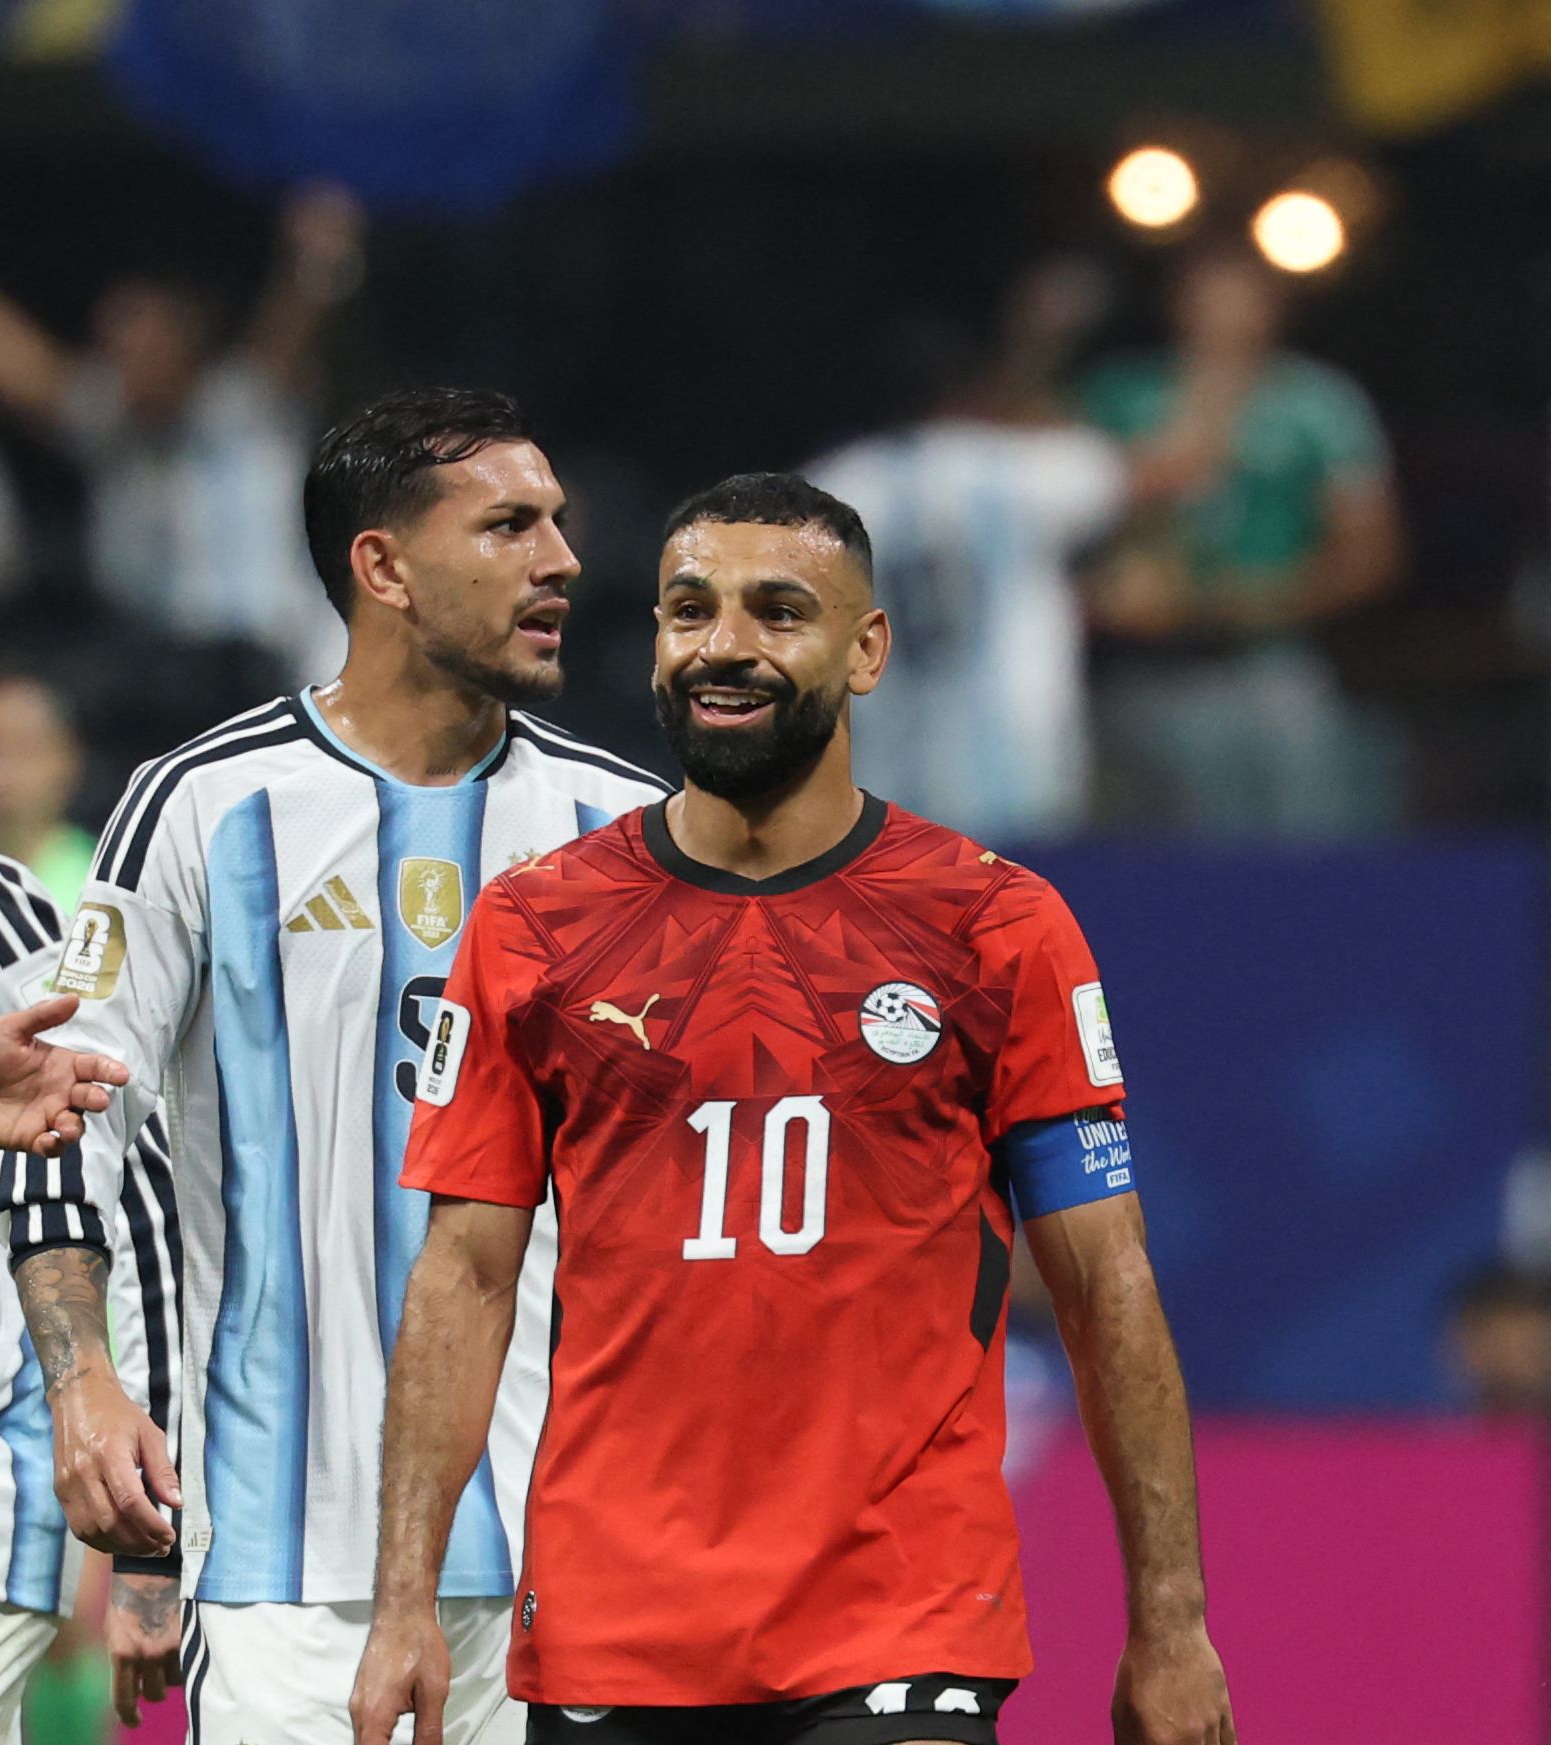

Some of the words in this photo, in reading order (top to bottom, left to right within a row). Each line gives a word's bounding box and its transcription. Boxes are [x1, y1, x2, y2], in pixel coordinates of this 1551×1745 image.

[416, 914, 447, 928] FIFA
[56, 976, 97, 993] 2026
[1081, 1150, 1109, 1175] the
[683, 1095, 830, 1260] 10
[1109, 1172, 1128, 1184] FIFA
